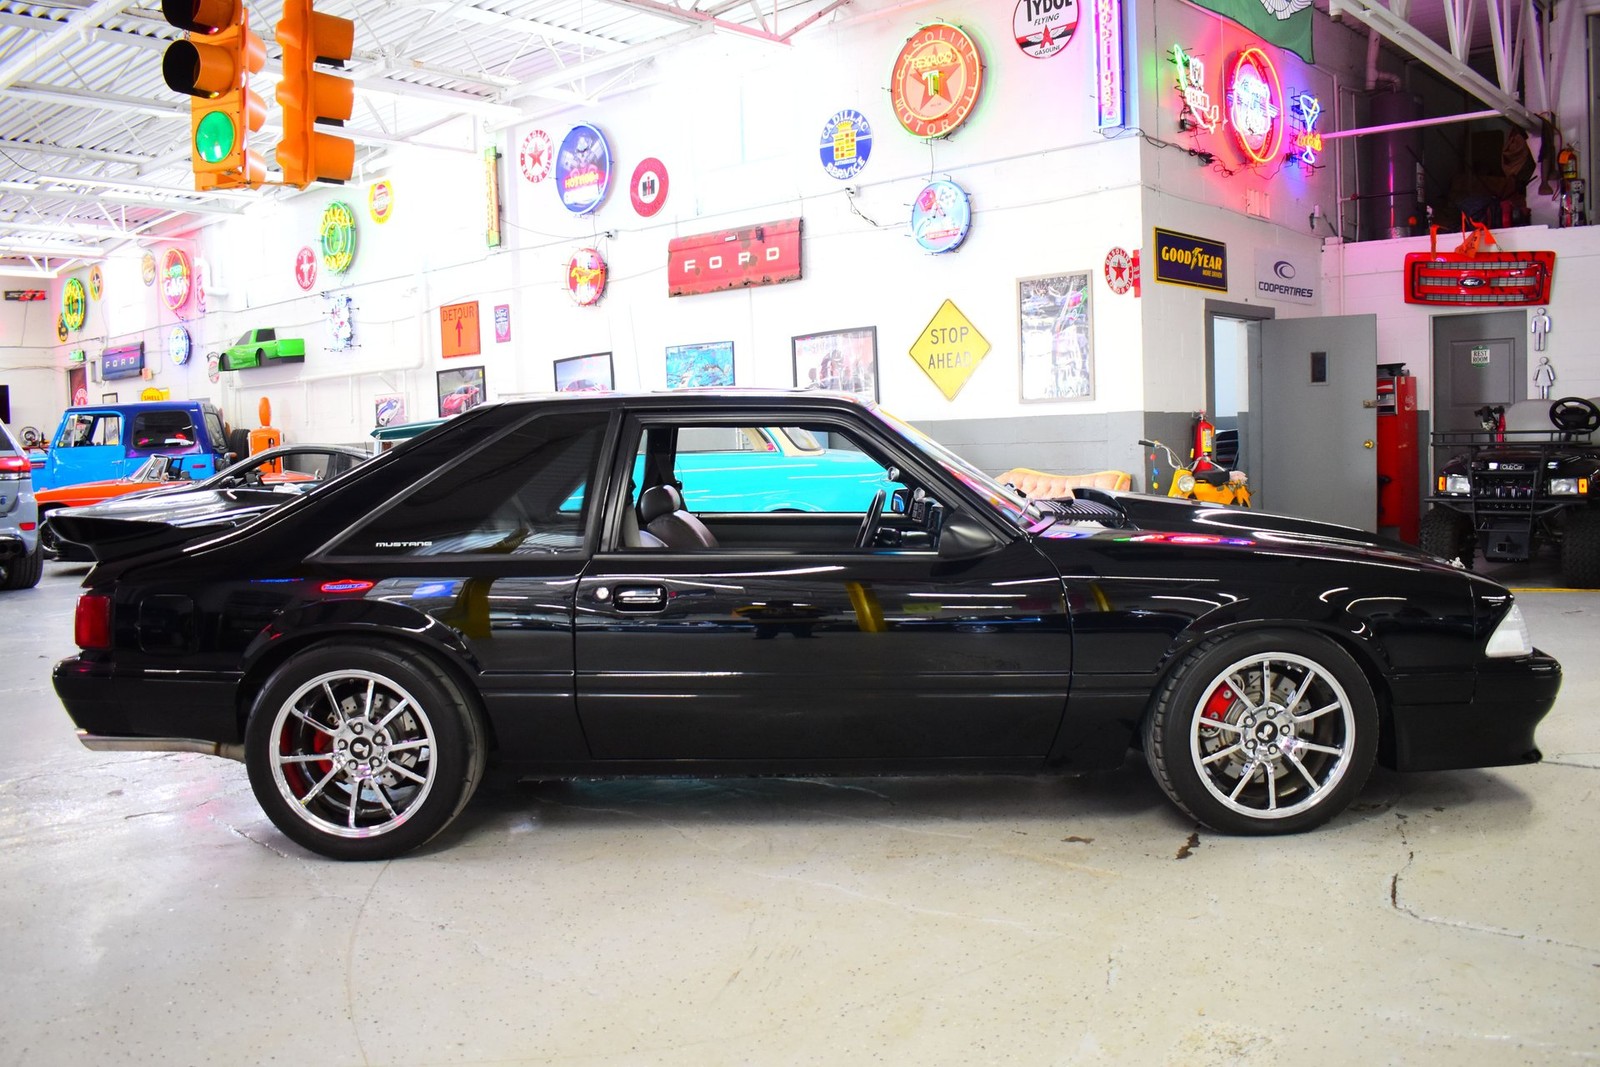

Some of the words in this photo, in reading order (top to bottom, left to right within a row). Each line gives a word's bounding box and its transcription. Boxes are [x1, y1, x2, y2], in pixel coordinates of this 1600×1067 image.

[1033, 13, 1060, 26] FLYING
[896, 29, 977, 80] GASOLINE
[1034, 45, 1061, 56] GASOLINE
[896, 99, 950, 135] MOTOR
[956, 86, 976, 118] OIL
[822, 110, 869, 139] CADILLAC
[826, 156, 866, 179] SERVICE
[684, 247, 780, 273] FORD
[1161, 246, 1223, 270] GOODYEAR
[443, 306, 475, 322] DETOUR
[930, 326, 969, 345] STOP
[105, 357, 135, 368] FORD
[928, 351, 972, 370] AHEAD
